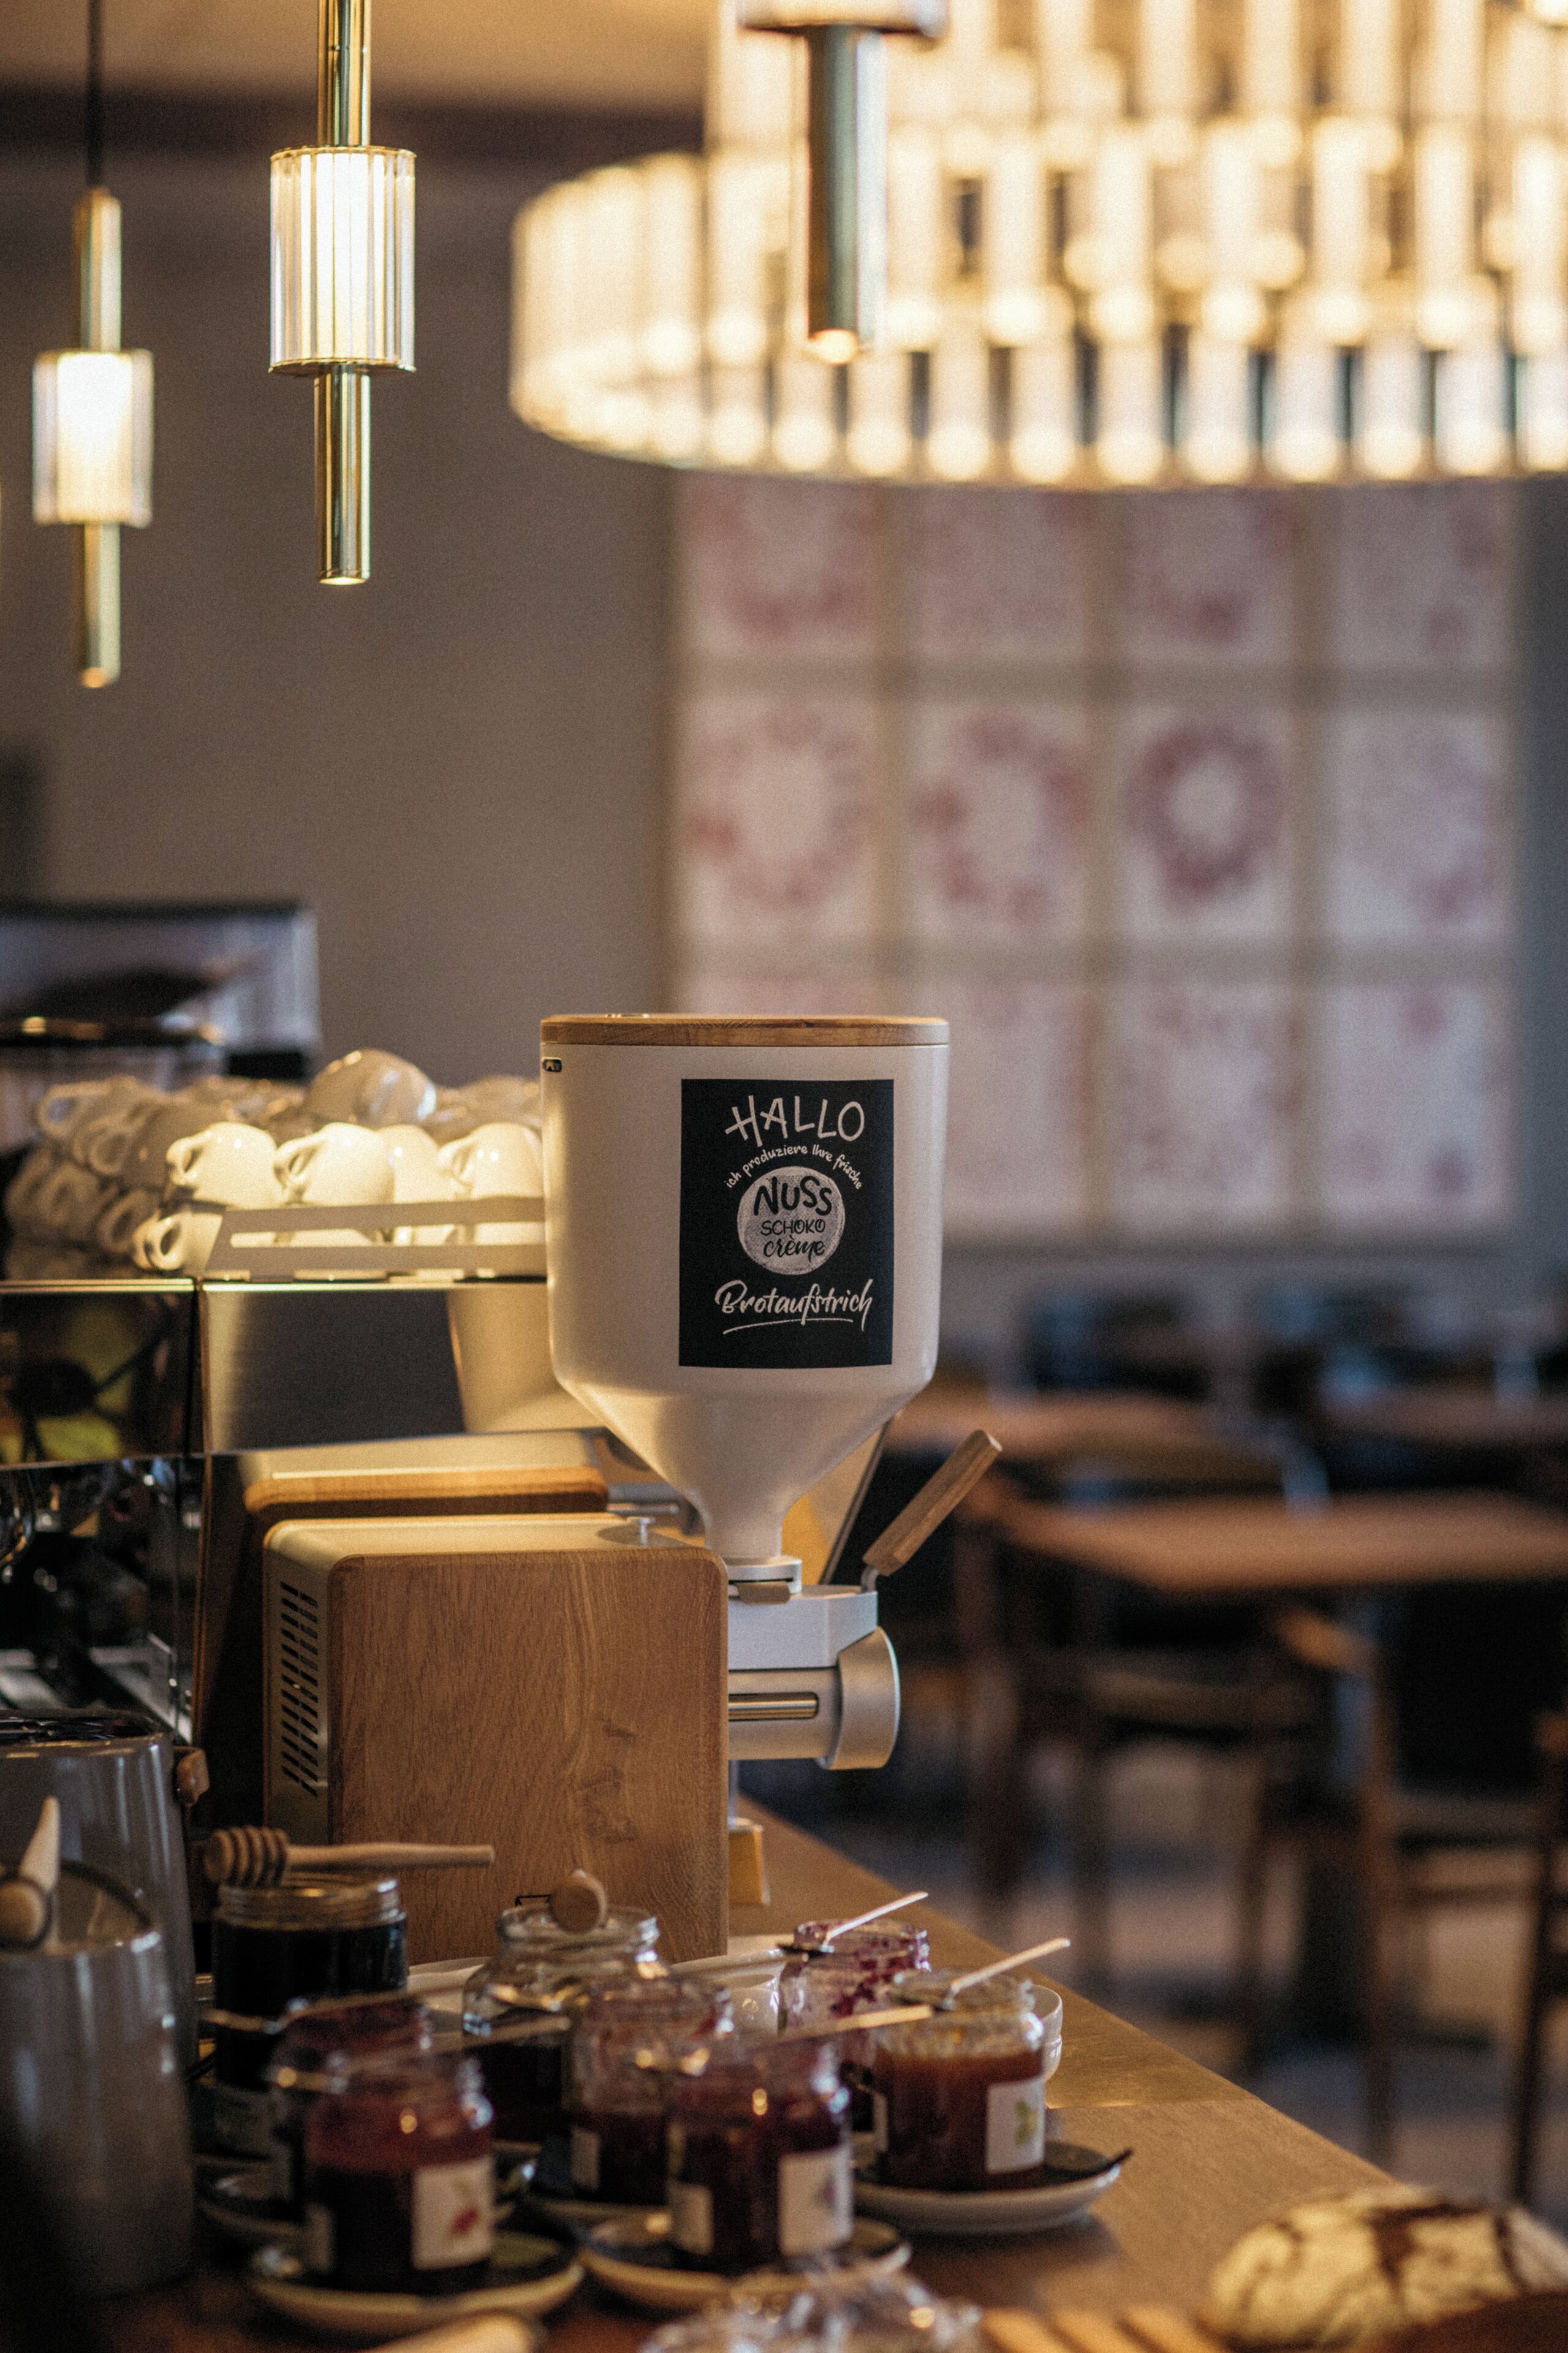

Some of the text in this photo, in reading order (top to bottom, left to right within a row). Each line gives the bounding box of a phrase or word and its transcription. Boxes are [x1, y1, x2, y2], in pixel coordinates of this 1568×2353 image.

[725, 1095, 865, 1147] HALLO
[724, 1144, 862, 1189] ich produziere Ihre frische
[753, 1175, 833, 1216] NUSS
[760, 1219, 825, 1236] SCHOKO
[763, 1235, 825, 1263] crème
[714, 1278, 873, 1332] Brotaufstrich
